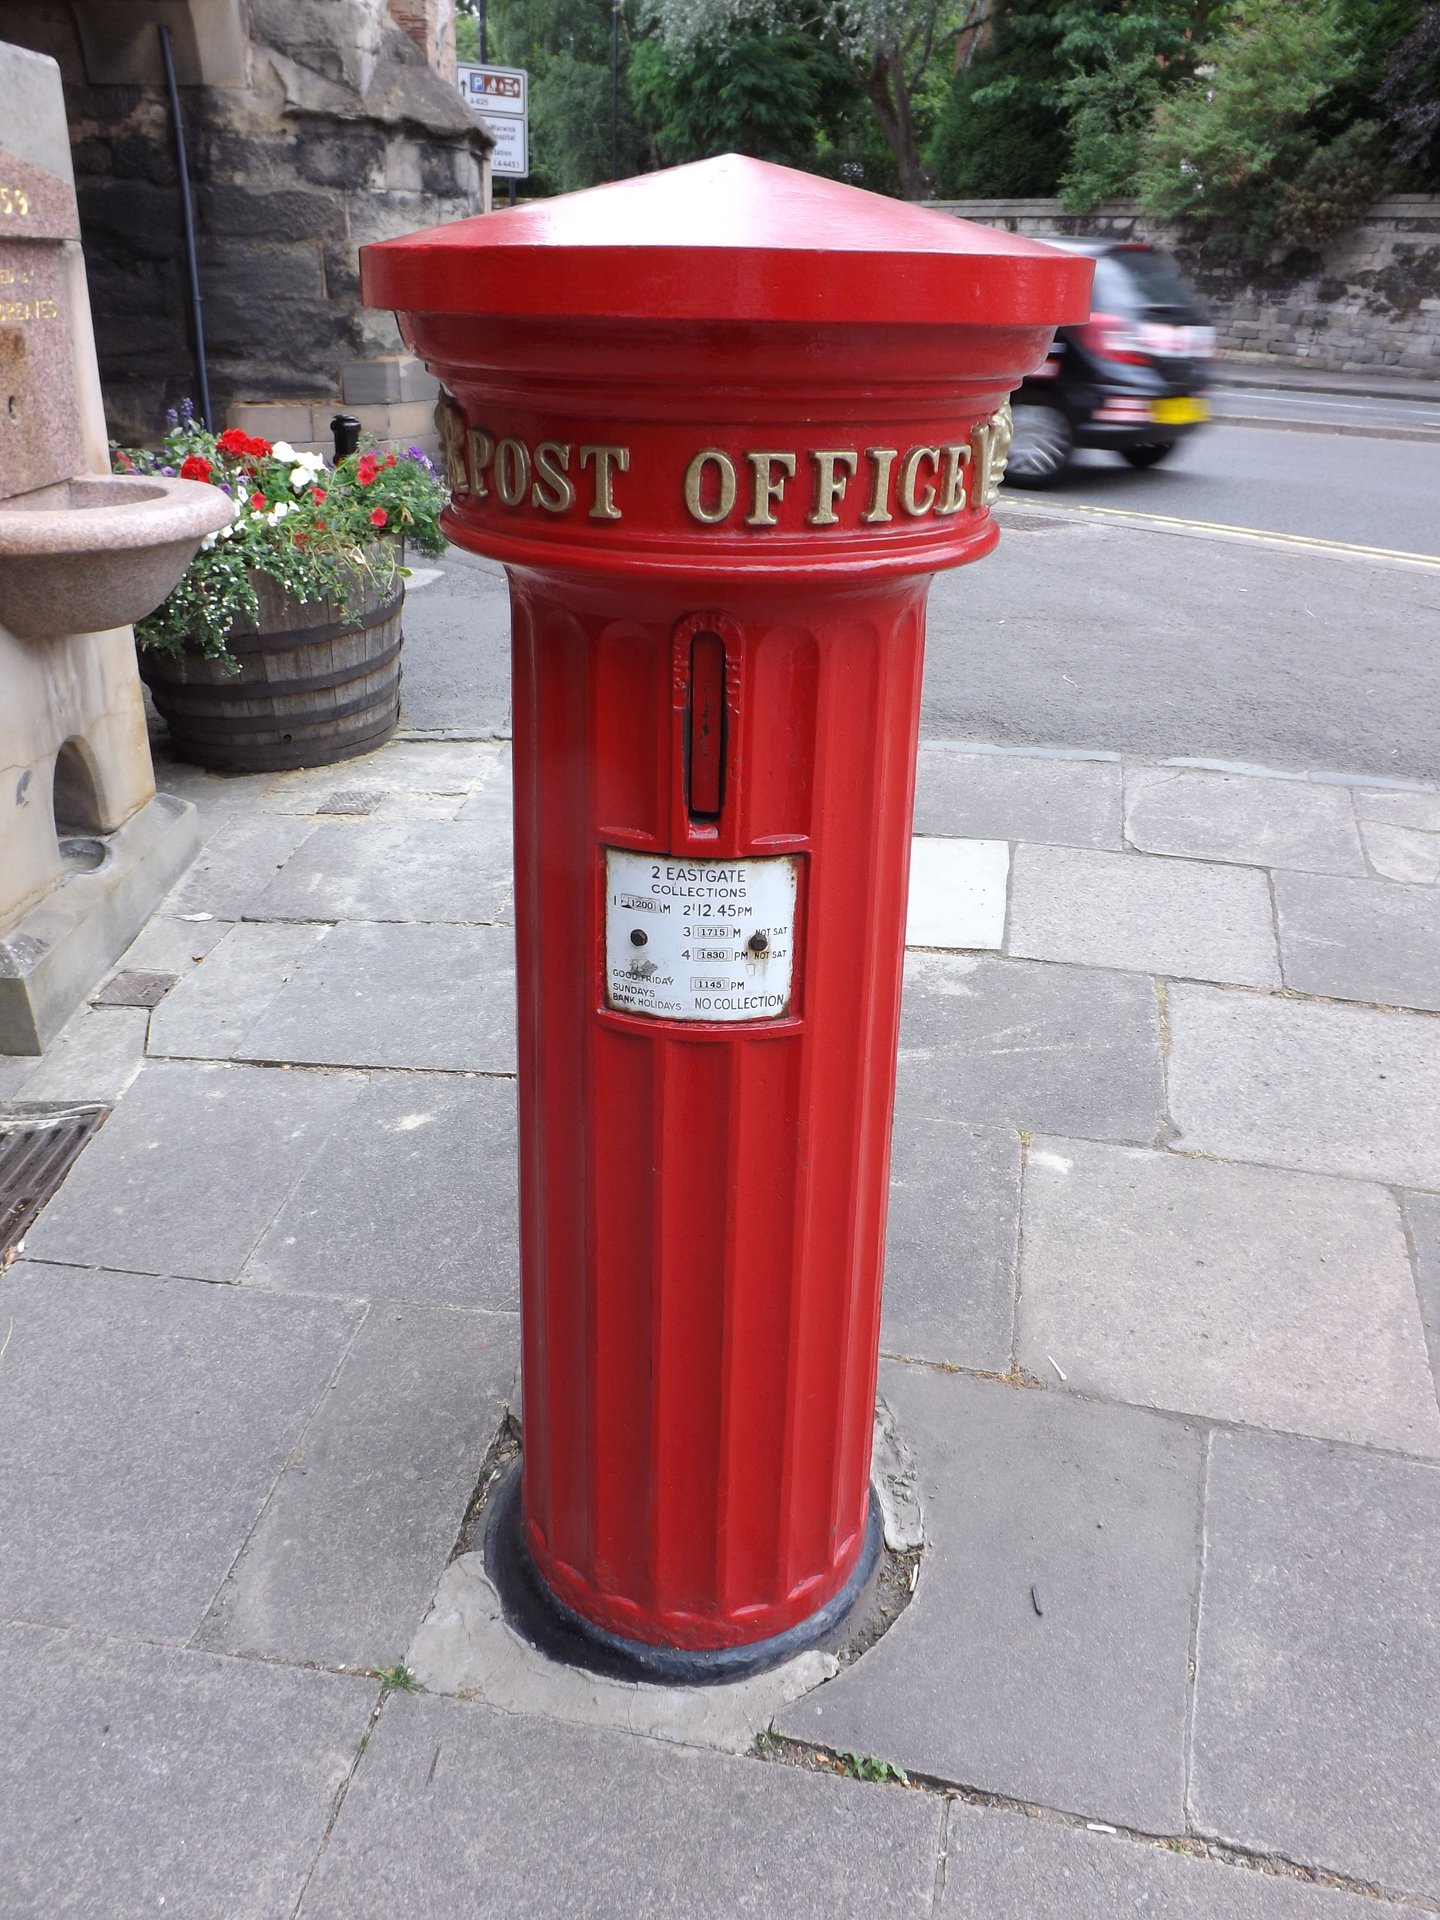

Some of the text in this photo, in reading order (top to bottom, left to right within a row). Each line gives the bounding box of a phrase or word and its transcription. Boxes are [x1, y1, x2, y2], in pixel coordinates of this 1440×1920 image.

[494, 149, 513, 157] tation
[467, 429, 972, 526] POST OFFICE
[651, 865, 746, 883] 2 EASTGATE
[651, 884, 747, 898] COLLECTIONS
[631, 899, 653, 910] 1200
[683, 926, 691, 937] 3
[701, 928, 726, 936] 1715
[755, 928, 771, 936] NOT
[773, 926, 788, 935] SAT
[681, 949, 787, 961] 4 1830 PM NOT SAT
[613, 968, 675, 986] GOOD FRIDAY
[613, 982, 656, 998] SUNDAYS
[699, 981, 745, 991] 1145 PM
[613, 992, 682, 1011] BANK HOLIDAYS
[694, 994, 784, 1010] NO COLLECTION
